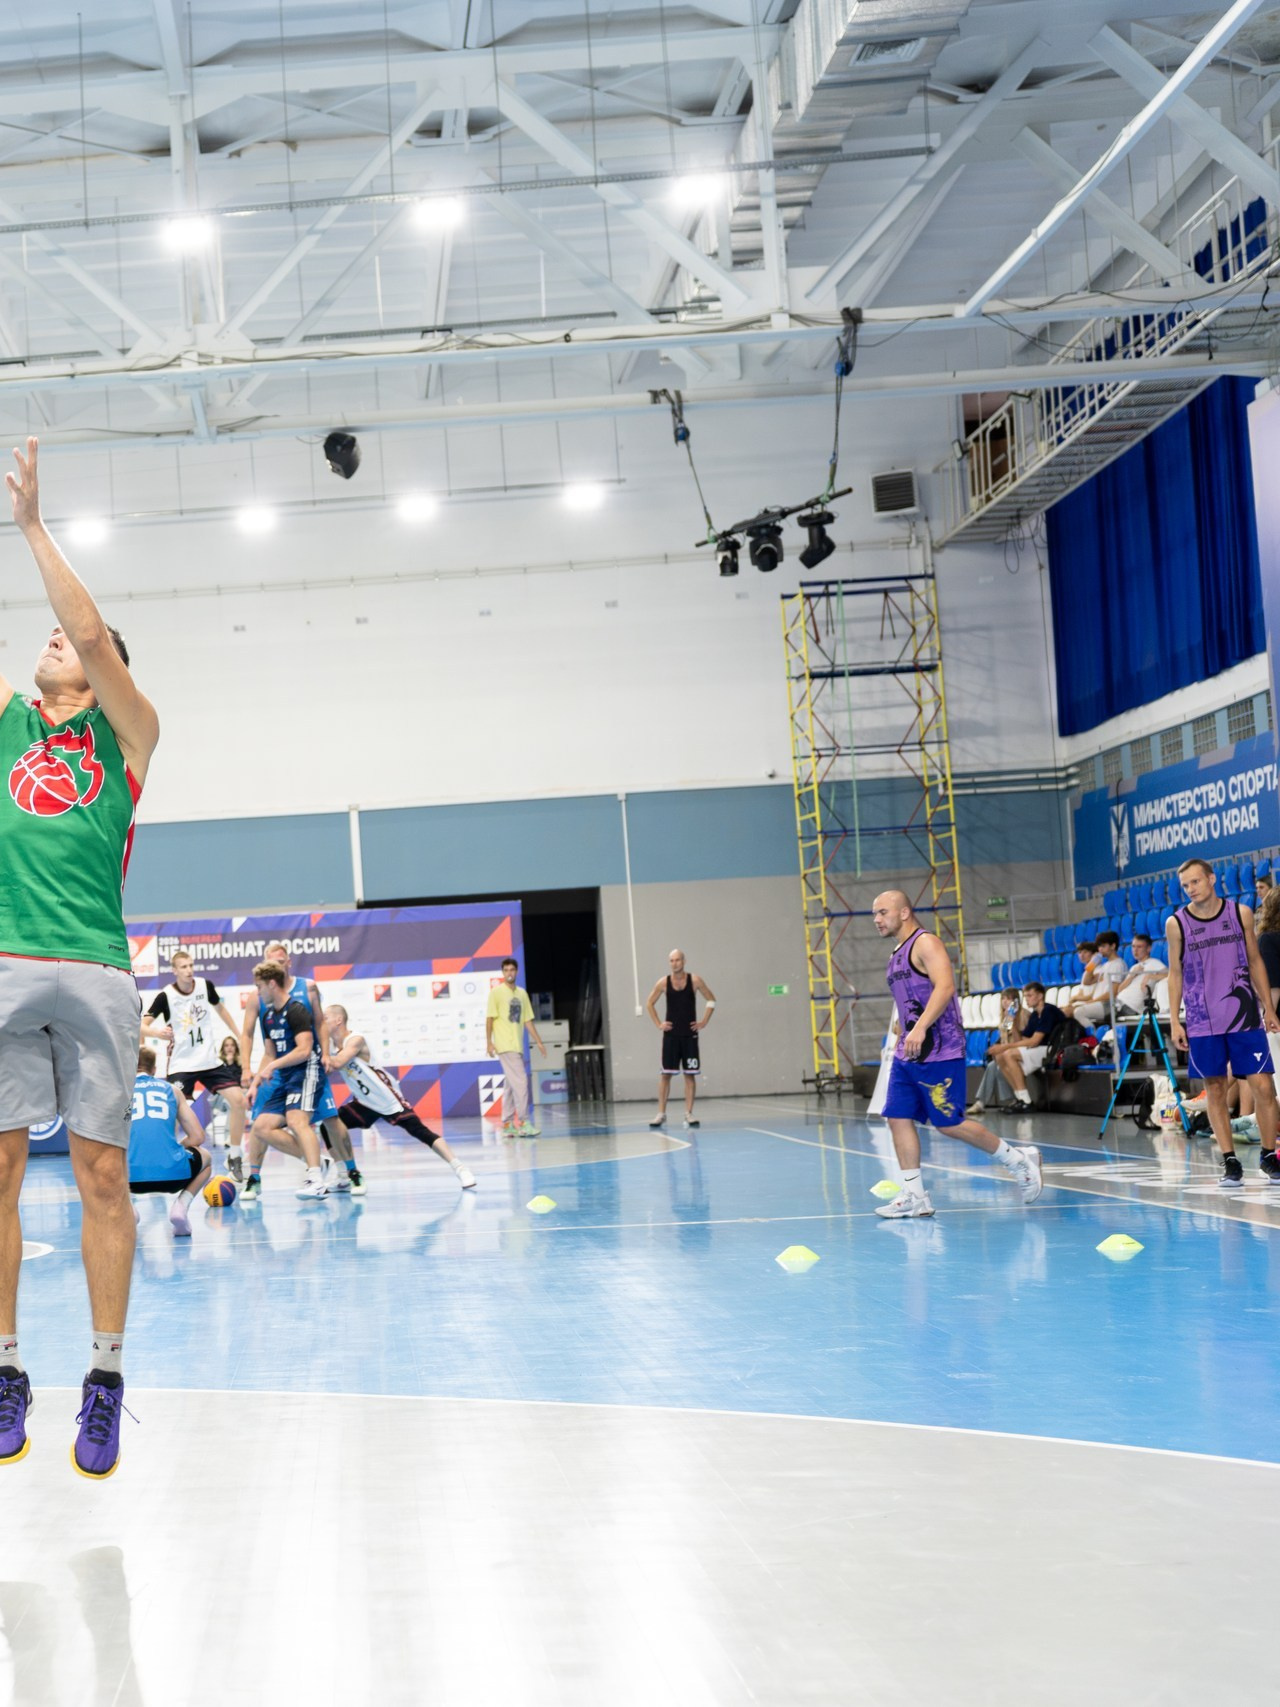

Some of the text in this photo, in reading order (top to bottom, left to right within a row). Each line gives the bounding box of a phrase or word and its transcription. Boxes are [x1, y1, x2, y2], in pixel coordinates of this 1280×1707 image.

[1133, 780, 1225, 828] МИНИСТЕРСТВО
[1135, 802, 1259, 857] ПРИМОРСКОГО КРАЯ
[269, 937, 340, 955] ОССИИ
[188, 1027, 203, 1047] 14
